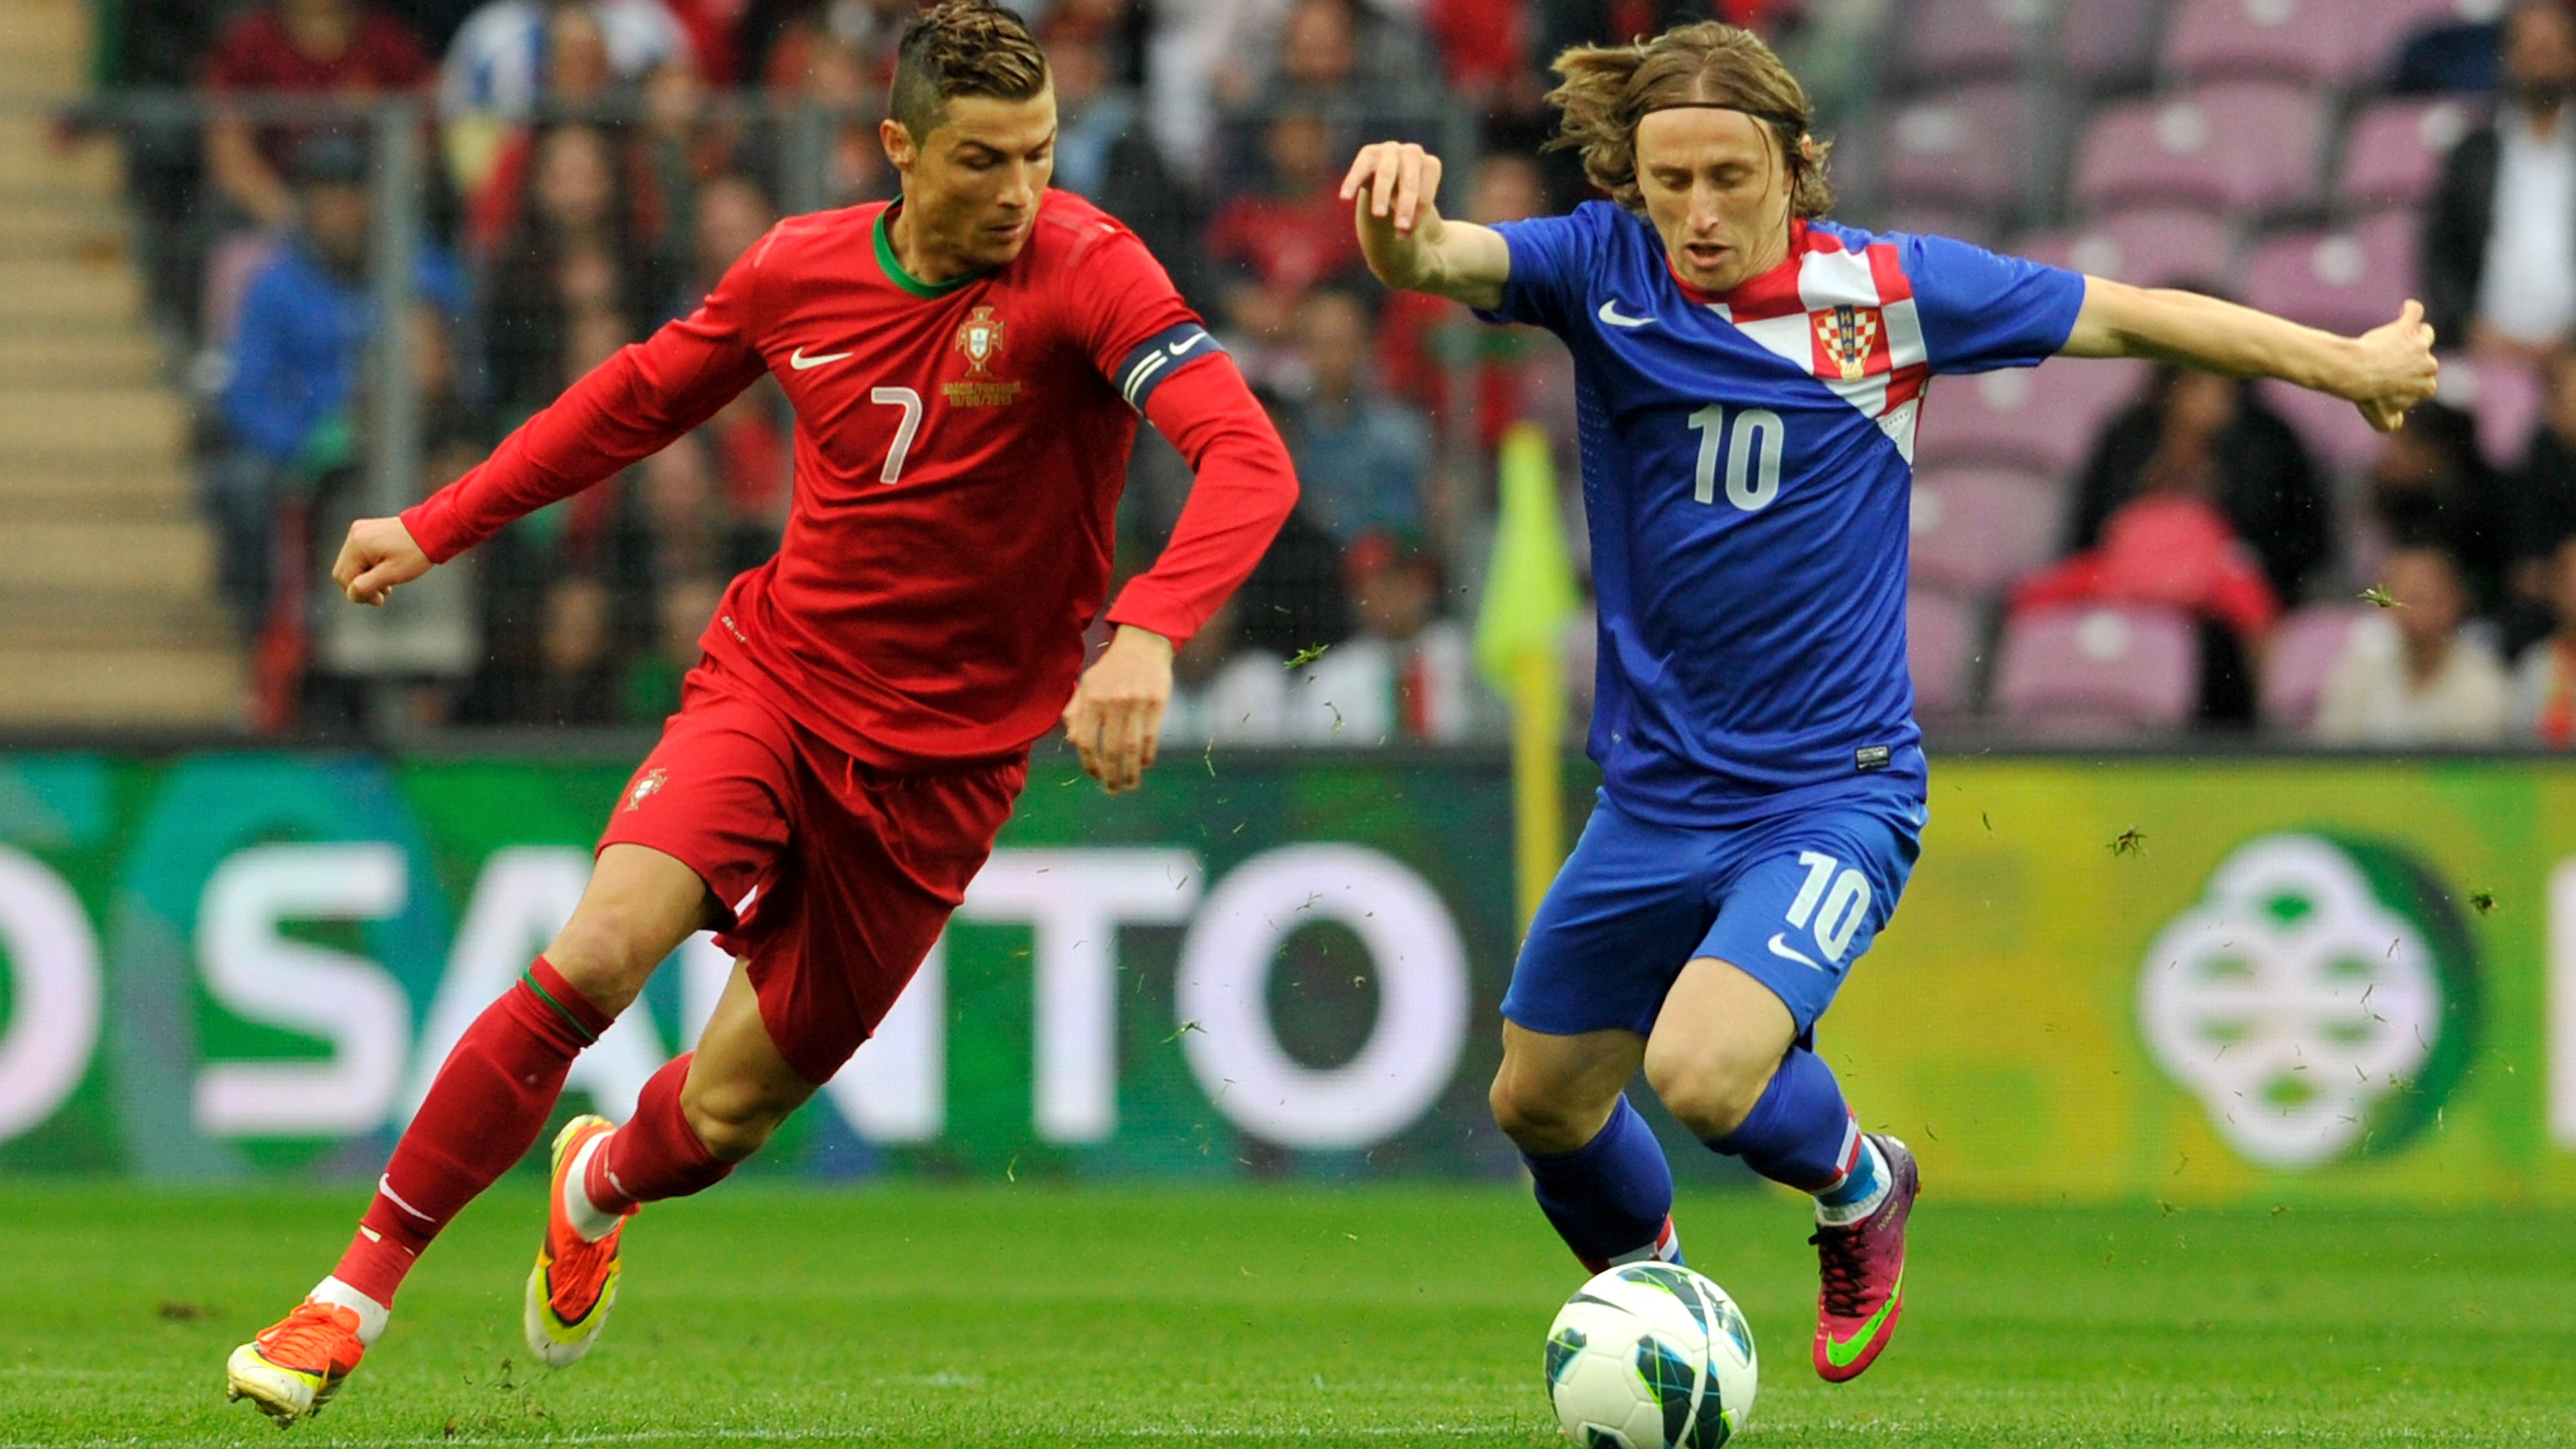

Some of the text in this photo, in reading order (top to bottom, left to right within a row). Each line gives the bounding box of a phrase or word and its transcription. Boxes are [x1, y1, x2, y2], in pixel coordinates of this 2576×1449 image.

[871, 386, 923, 484] 7
[1688, 403, 1784, 512] 10
[1785, 850, 1871, 962] 10
